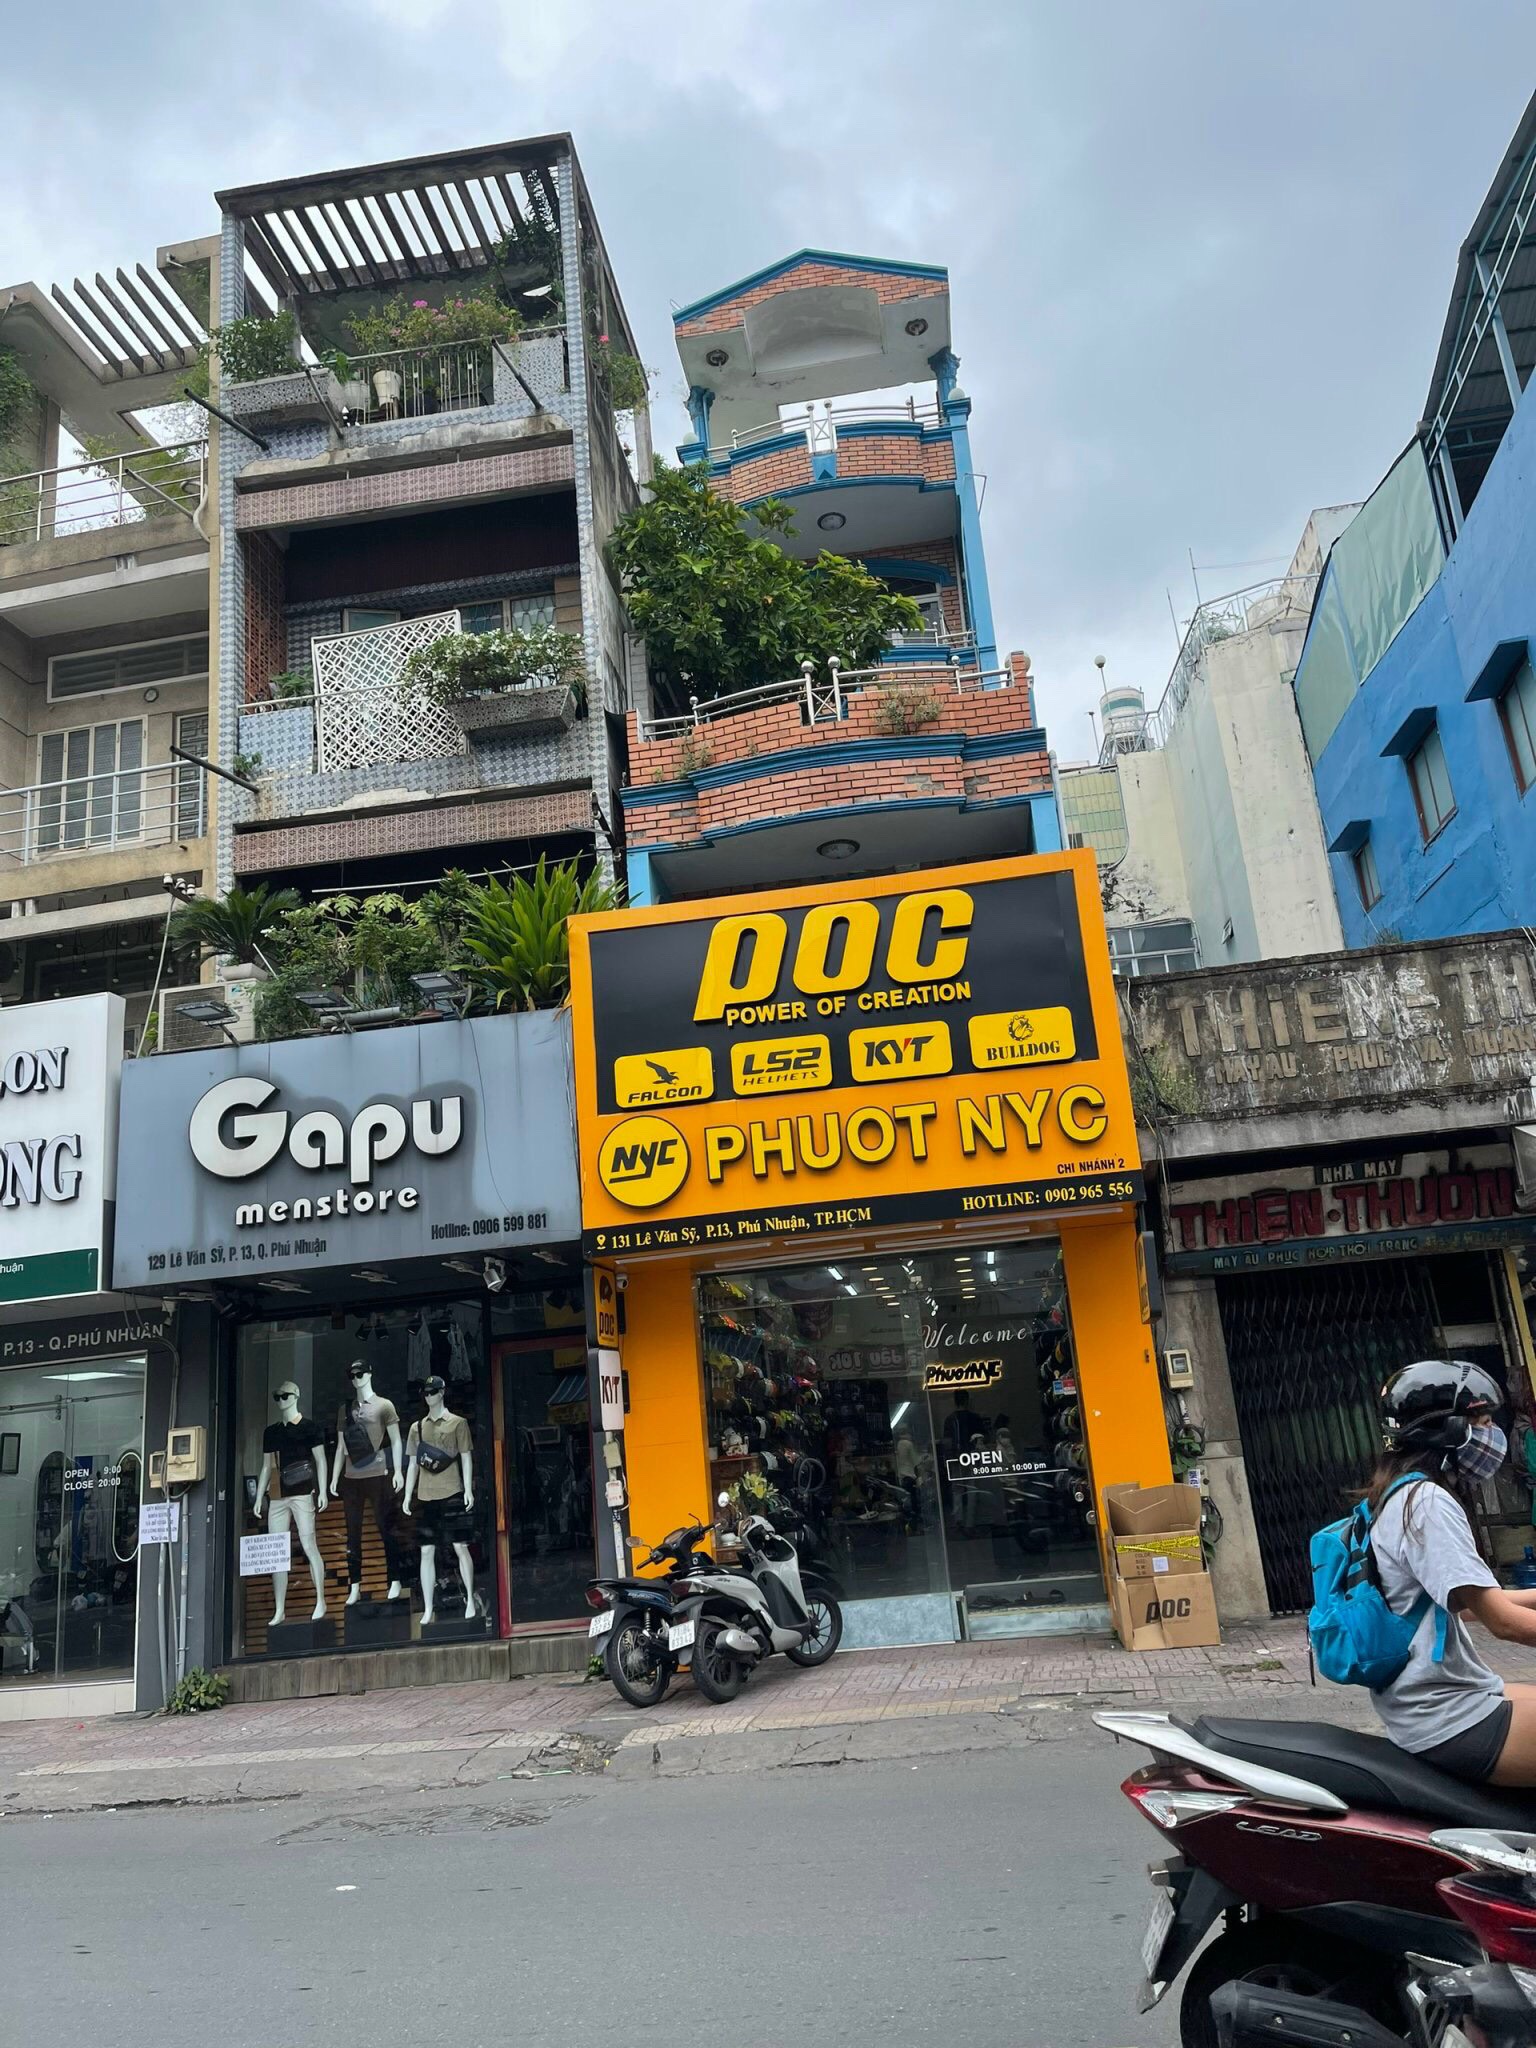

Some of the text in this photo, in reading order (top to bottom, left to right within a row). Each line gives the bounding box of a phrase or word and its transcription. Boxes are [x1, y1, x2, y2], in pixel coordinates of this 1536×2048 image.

[693, 887, 976, 1023] POC
[726, 981, 973, 1028] POWER OF CREATION
[742, 1047, 822, 1076] LS2
[863, 1035, 936, 1067] KYT
[986, 1040, 1061, 1062] BULLDOG
[0, 1046, 69, 1098] ON
[743, 1070, 819, 1087] HELMETS
[628, 1085, 703, 1104] FALCON
[188, 1076, 465, 1184] Gapu
[704, 1084, 1109, 1184] PHUOT NYC
[0, 1133, 83, 1207] NG
[608, 1138, 679, 1184] NYC
[1057, 1158, 1125, 1175] CHI NHÁNH 2
[234, 1186, 420, 1227] menstore
[963, 1181, 1134, 1211] HOTLINE: 0902 965 556
[431, 1213, 547, 1240] Hotline: 0906 599 881
[612, 1207, 872, 1249] 131 Lê Văn Sỹ, P.13, Phú Nhuận, TP.HCM
[148, 1254, 166, 1270] 129
[169, 1251, 183, 1268] Lê
[229, 1246, 239, 1262] P.
[240, 1245, 255, 1262] 13,
[257, 1243, 268, 1259] Q.
[271, 1239, 291, 1257] Phú
[294, 1238, 327, 1257] Nhuận
[599, 1311, 615, 1337] POC
[918, 1323, 1027, 1348] Welcome
[4, 1340, 34, 1356] P.13
[49, 1327, 101, 1350] Q.PHÚ
[601, 1375, 621, 1404] KYT
[64, 1465, 122, 1479] OPEN 9:00
[959, 1451, 1003, 1466] OPEN
[973, 1466, 990, 1475] 9:00
[1011, 1462, 1033, 1471] 10:00
[1034, 1462, 1047, 1471] pm
[64, 1477, 121, 1491] CLOSE 20:00
[1146, 1597, 1191, 1624] POC
[1236, 1821, 1323, 1841] LEAD
